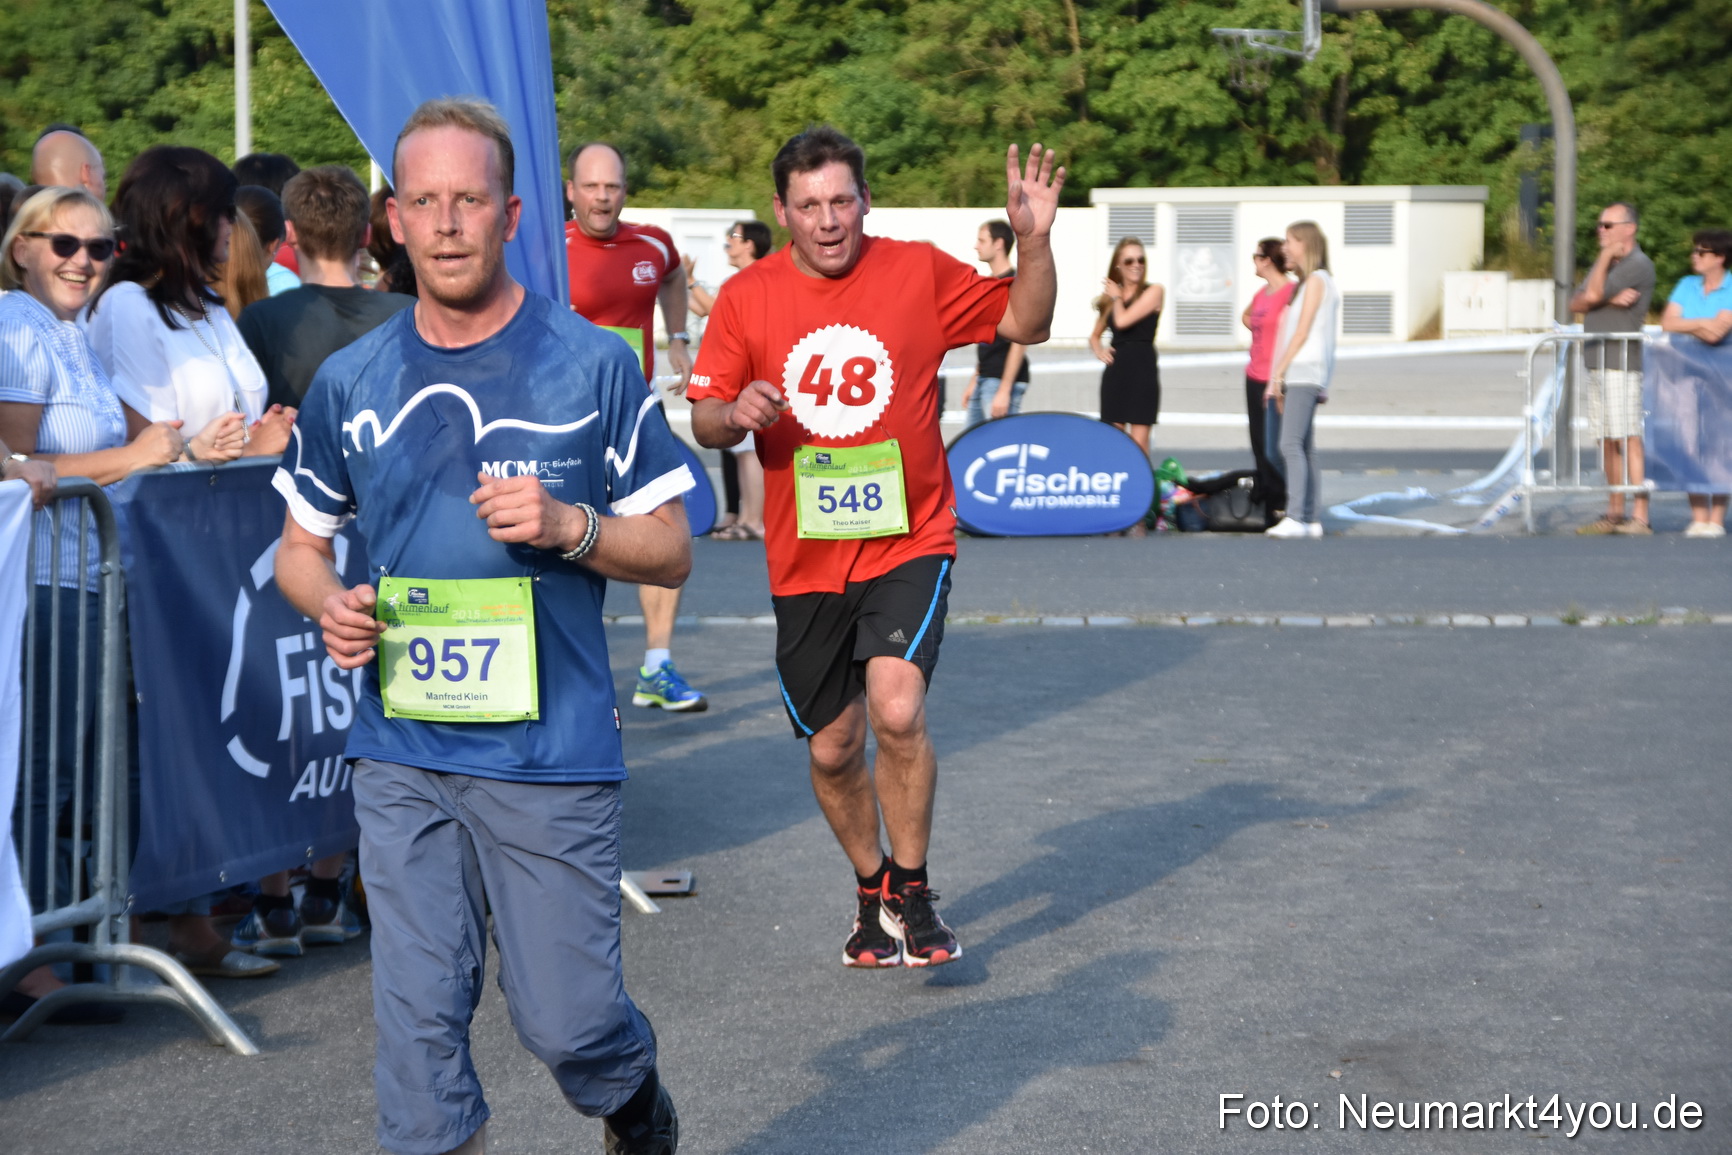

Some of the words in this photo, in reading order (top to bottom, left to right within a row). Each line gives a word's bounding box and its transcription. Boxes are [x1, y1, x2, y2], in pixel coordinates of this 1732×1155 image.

[481, 460, 538, 479] MCM
[995, 465, 1129, 496] Fischer
[818, 482, 883, 514] 548
[1010, 494, 1121, 510] AUTOMOBILE
[399, 602, 450, 613] firmenlauf
[452, 609, 481, 619] 2015
[408, 637, 500, 682] 957
[426, 692, 462, 701] Manfred
[464, 692, 488, 701] Klein
